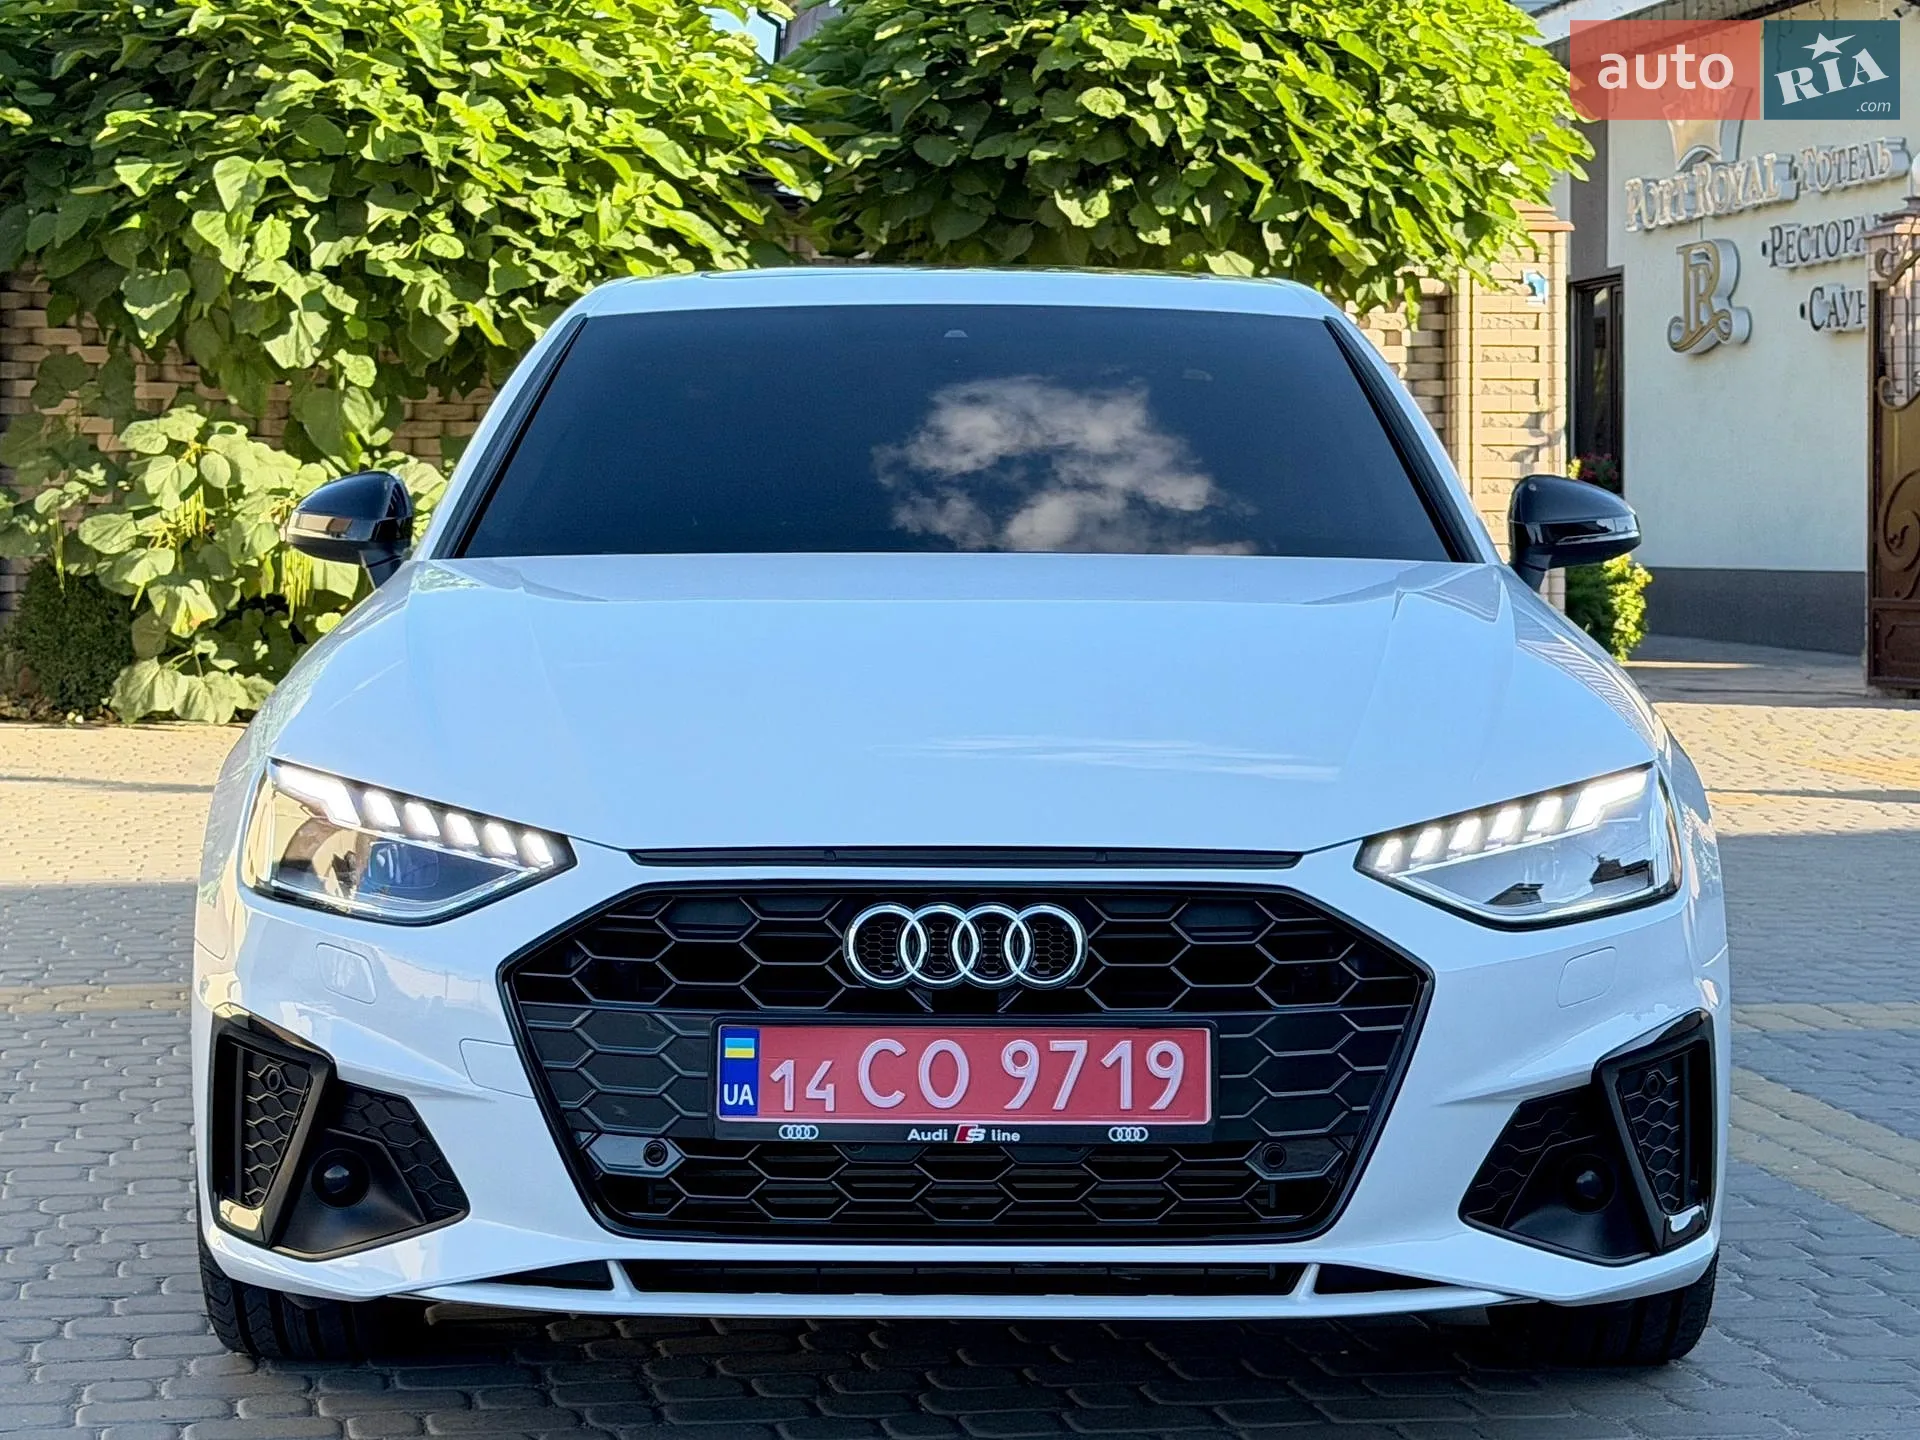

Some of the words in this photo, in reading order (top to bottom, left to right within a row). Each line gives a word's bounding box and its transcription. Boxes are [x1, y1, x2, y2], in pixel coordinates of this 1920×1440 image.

[1692, 152, 1780, 218] ROYAL
[1799, 137, 1893, 192] ГОТЕЛЬ
[723, 1083, 755, 1106] UA
[769, 1059, 835, 1112] 14
[858, 1038, 970, 1110] CO
[1001, 1039, 1184, 1111] 9719
[907, 1128, 948, 1141] Audi
[991, 1129, 1020, 1142] line
